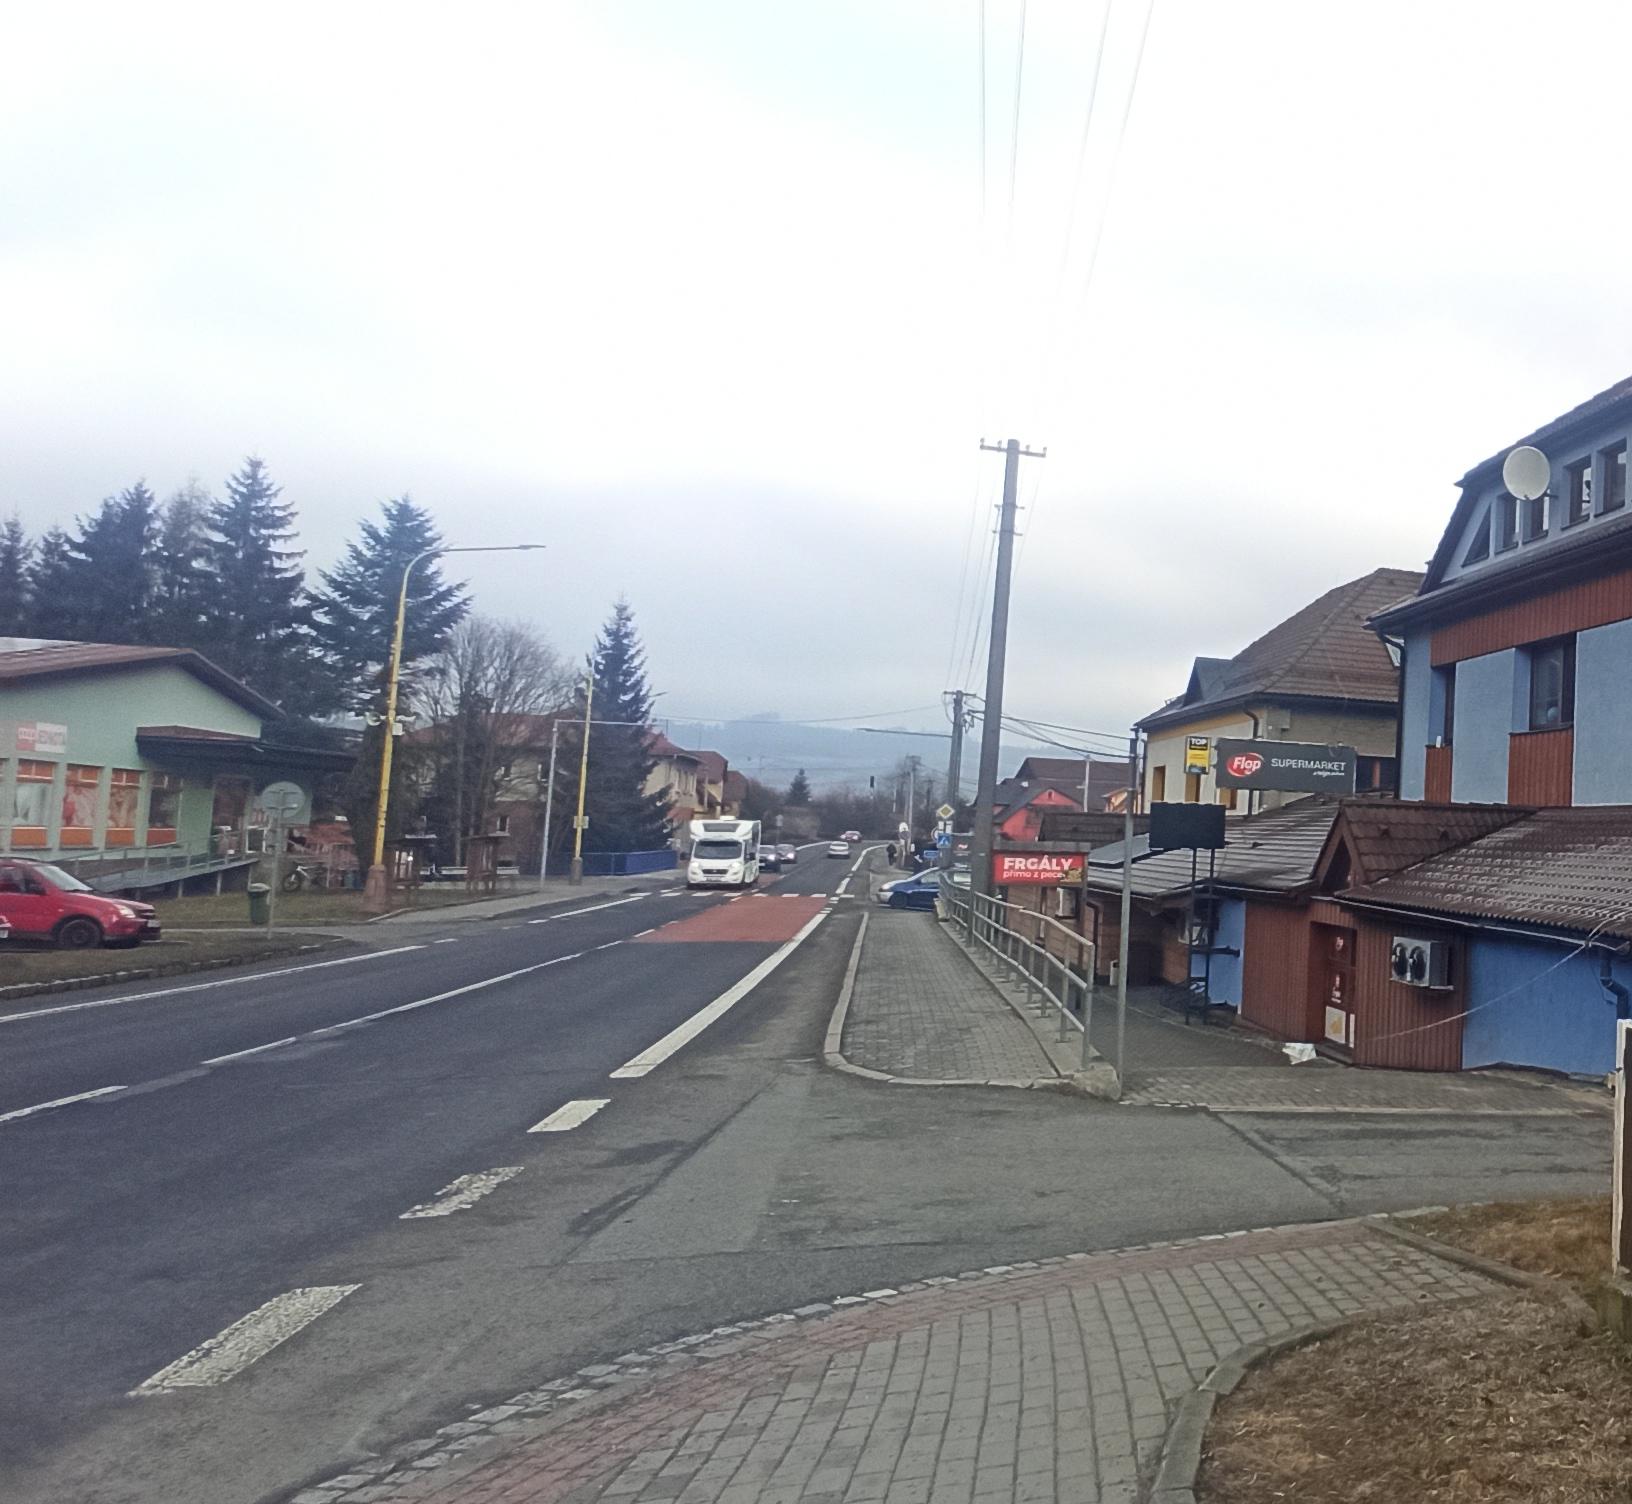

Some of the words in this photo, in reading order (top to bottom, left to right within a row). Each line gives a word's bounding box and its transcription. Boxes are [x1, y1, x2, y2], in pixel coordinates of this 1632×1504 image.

[1232, 756, 1262, 772] Flop
[1271, 758, 1347, 771] SUPERMARKET
[1003, 854, 1073, 871] FRGÁLY
